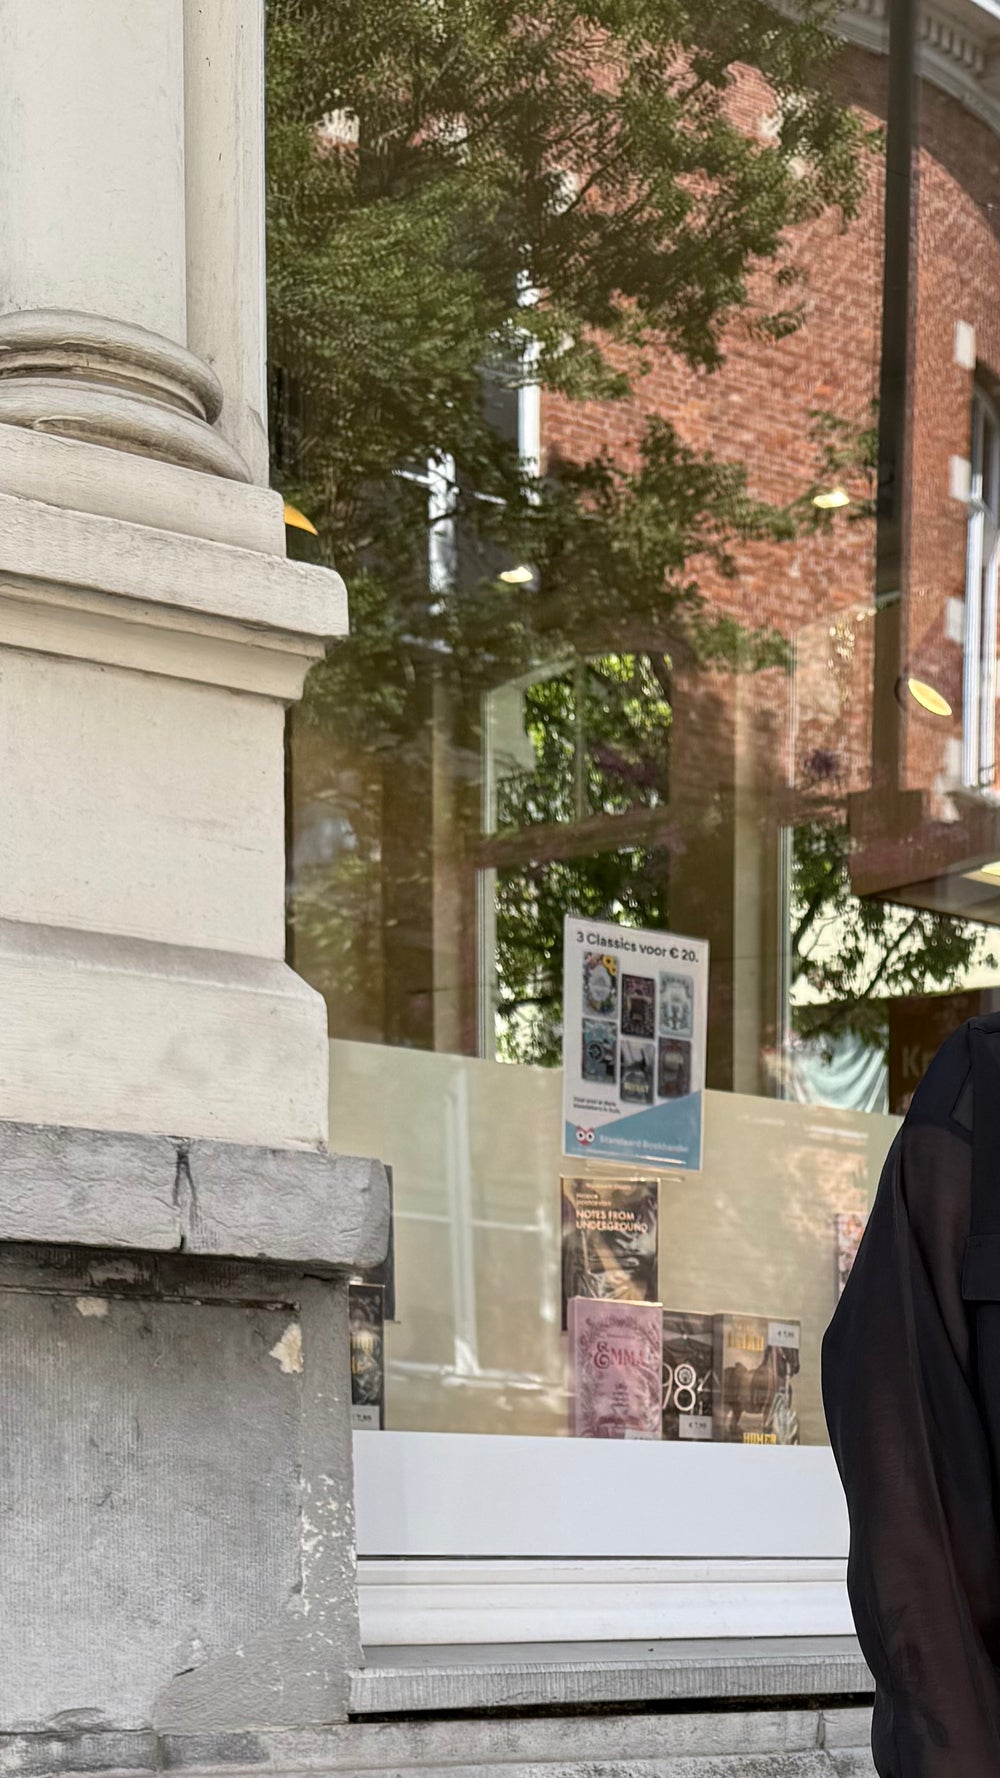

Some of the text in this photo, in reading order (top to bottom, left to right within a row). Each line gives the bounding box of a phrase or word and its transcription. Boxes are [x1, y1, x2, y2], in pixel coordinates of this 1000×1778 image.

[576, 931, 699, 963] 3 Classics voor € 20.
[575, 1209, 635, 1221] NOTES FROM
[575, 1221, 649, 1234] UNDERGROUND
